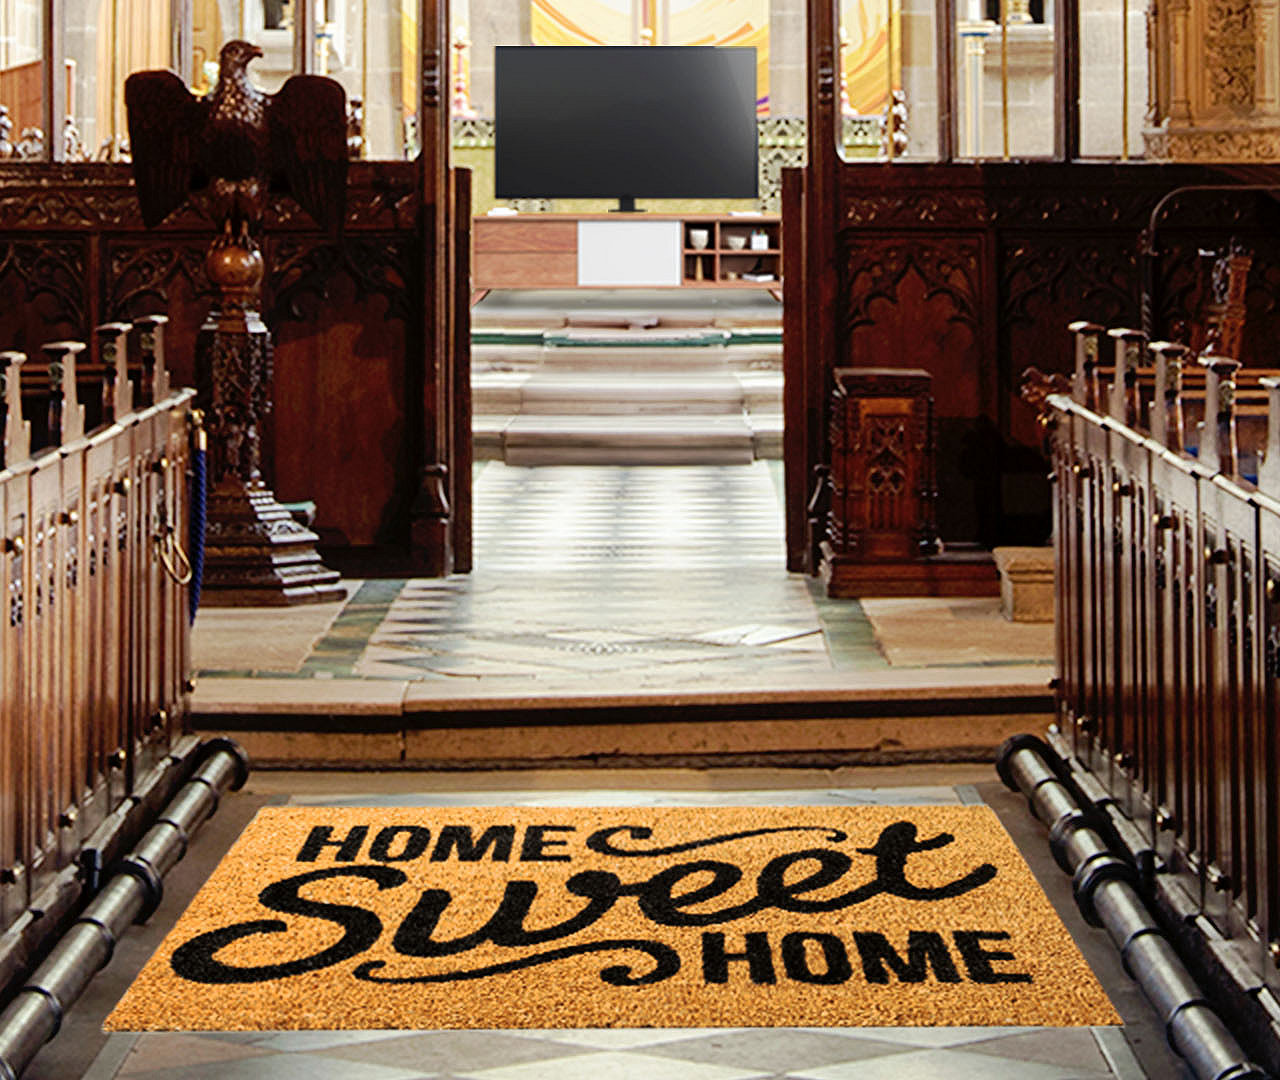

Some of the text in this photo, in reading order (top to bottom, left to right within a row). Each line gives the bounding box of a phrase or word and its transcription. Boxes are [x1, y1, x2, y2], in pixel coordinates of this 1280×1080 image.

[297, 825, 576, 863] HOME
[171, 821, 998, 986] Sweet
[702, 931, 1033, 986] HOME
